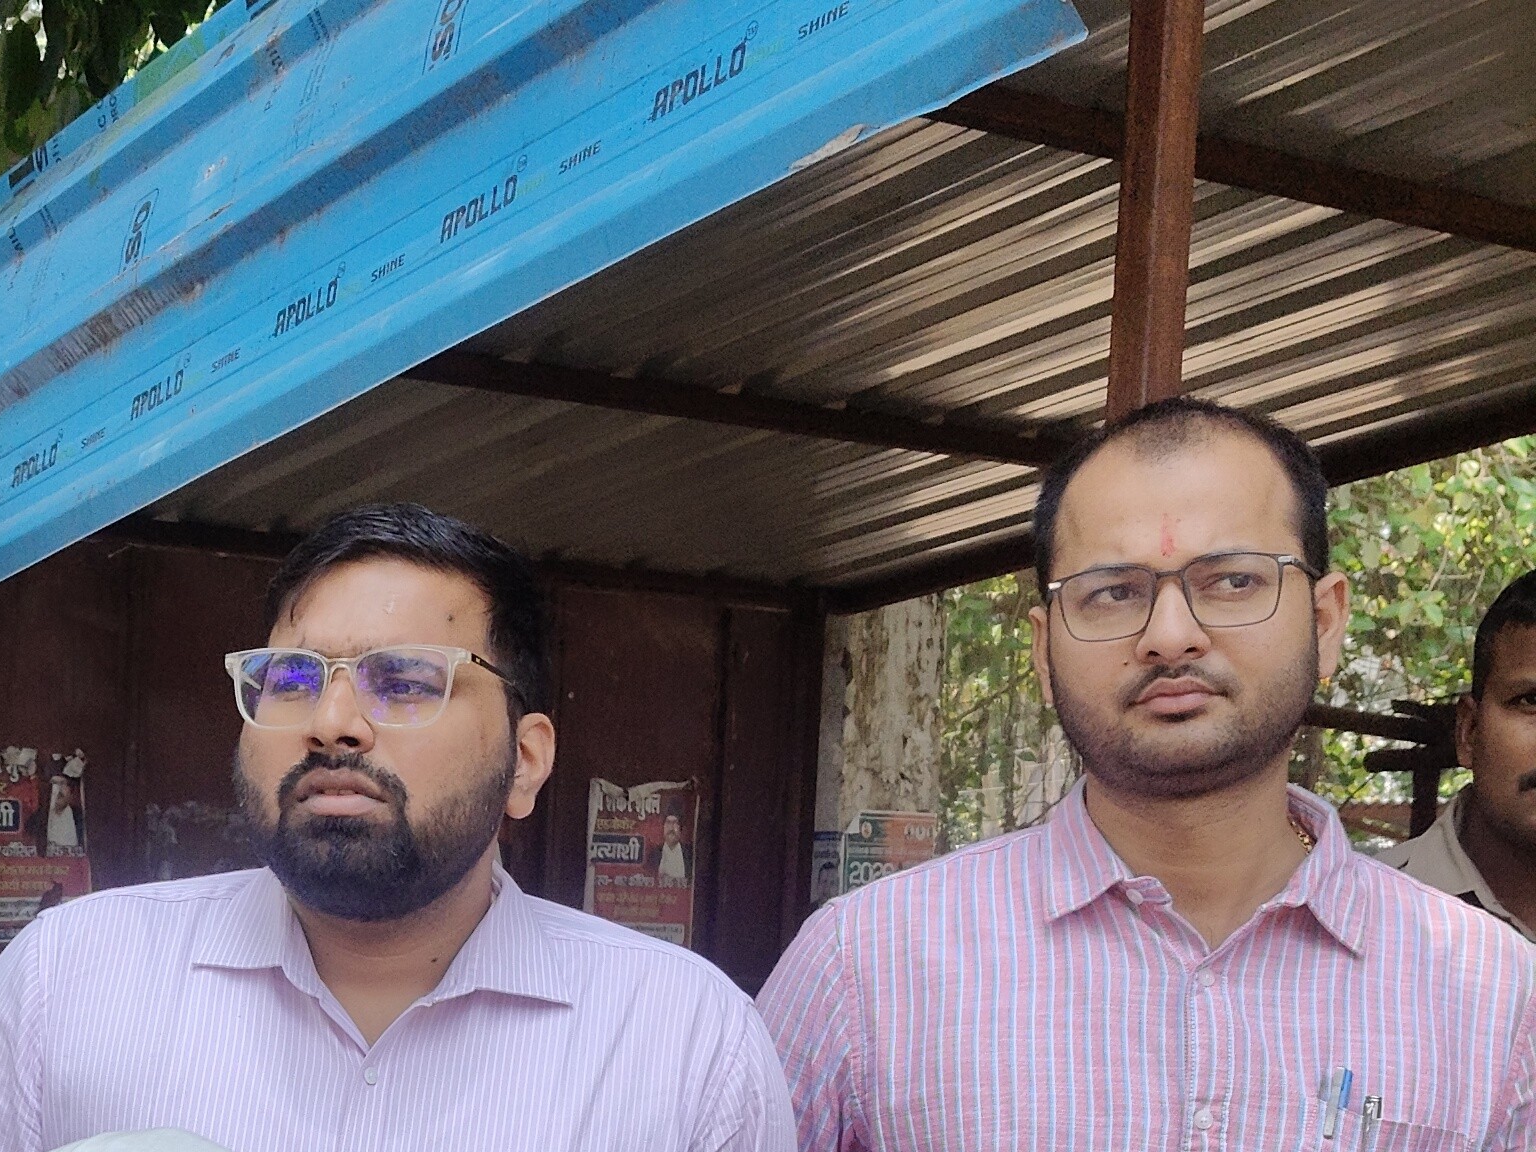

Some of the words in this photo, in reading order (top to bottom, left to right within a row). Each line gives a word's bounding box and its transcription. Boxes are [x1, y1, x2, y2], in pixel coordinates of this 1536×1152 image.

[131, 369, 184, 420] APOLLO
[275, 279, 338, 337] APOLLO
[371, 253, 406, 282] SHINE
[440, 174, 518, 244] APOLLO
[558, 139, 602, 175] SHINE
[651, 41, 747, 122] APOLLO
[797, 1, 850, 40] SHINE
